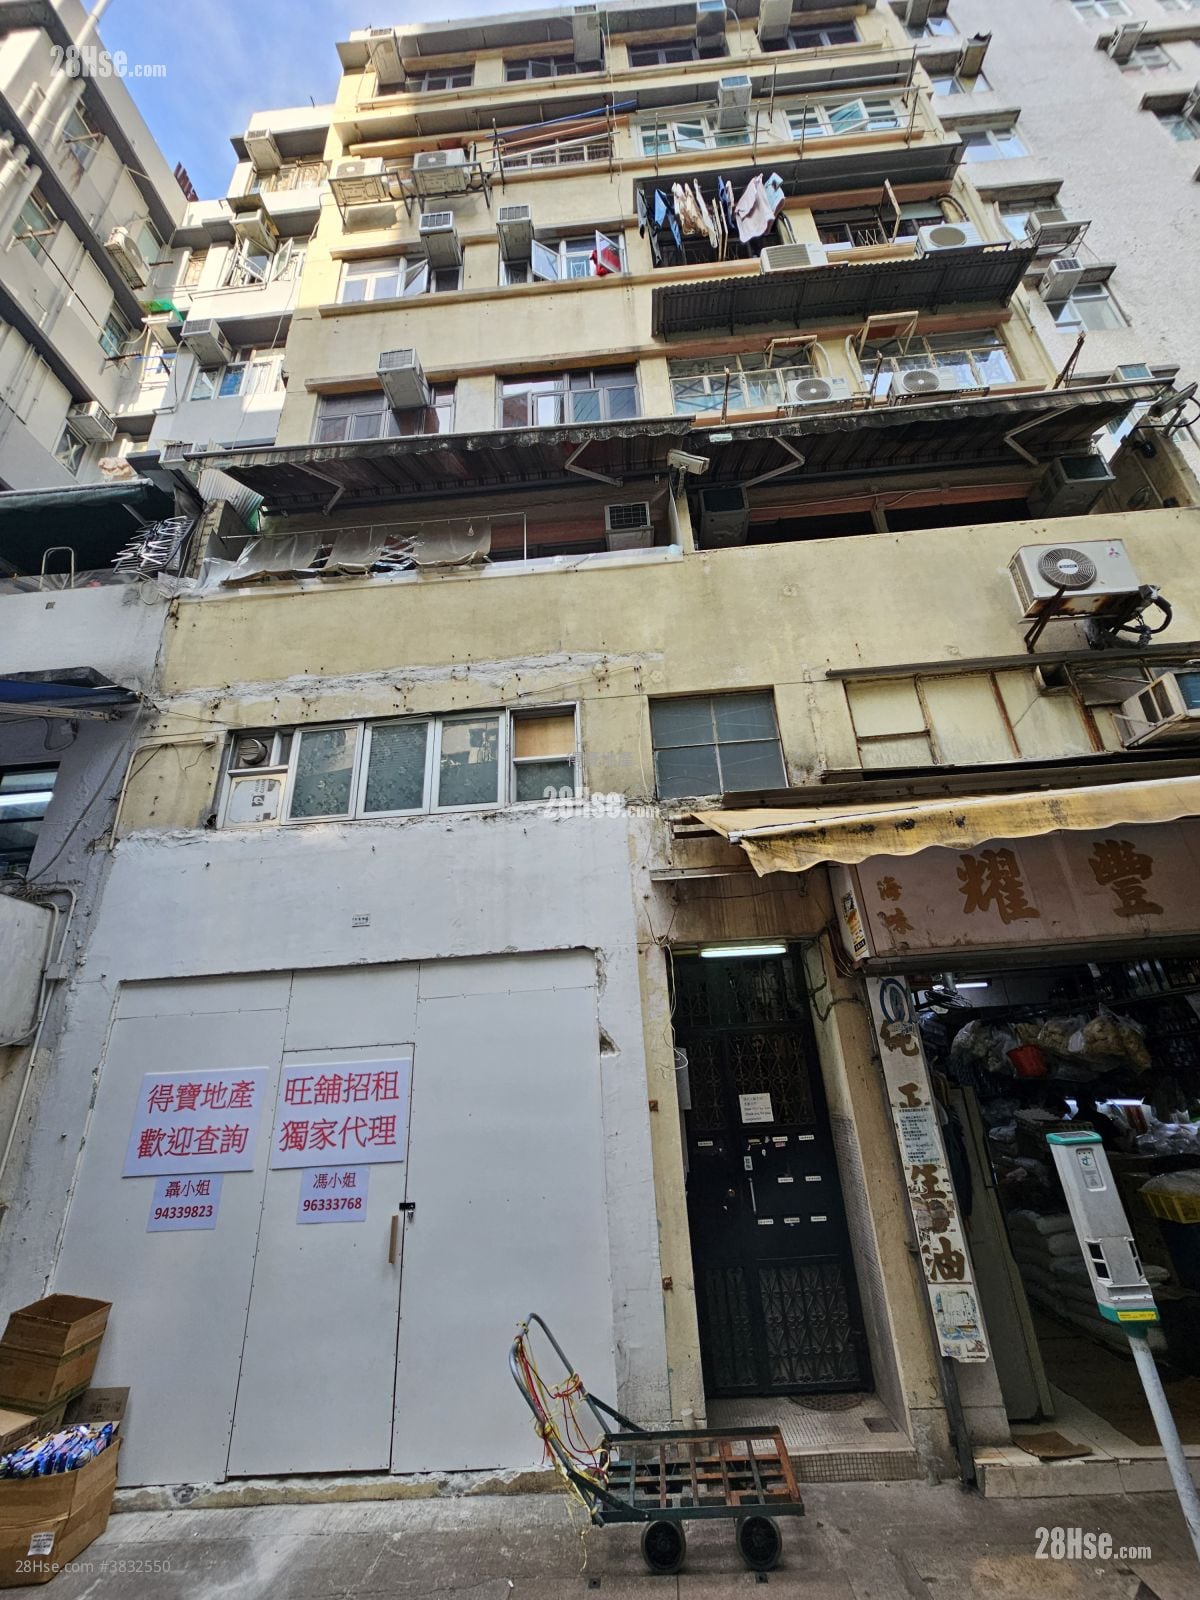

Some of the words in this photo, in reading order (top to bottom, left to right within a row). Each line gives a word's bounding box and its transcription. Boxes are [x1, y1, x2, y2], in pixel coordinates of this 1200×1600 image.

[148, 1079, 255, 1115] 得寶地產
[284, 1070, 399, 1107] 旺舖招租
[137, 1124, 249, 1159] 歡迎查詢
[279, 1114, 397, 1152] 獨家代理
[164, 1179, 211, 1199] 聶小姐
[312, 1171, 356, 1190] 馮小姐
[154, 1205, 213, 1220] 94339823
[303, 1197, 363, 1212] 96333768
